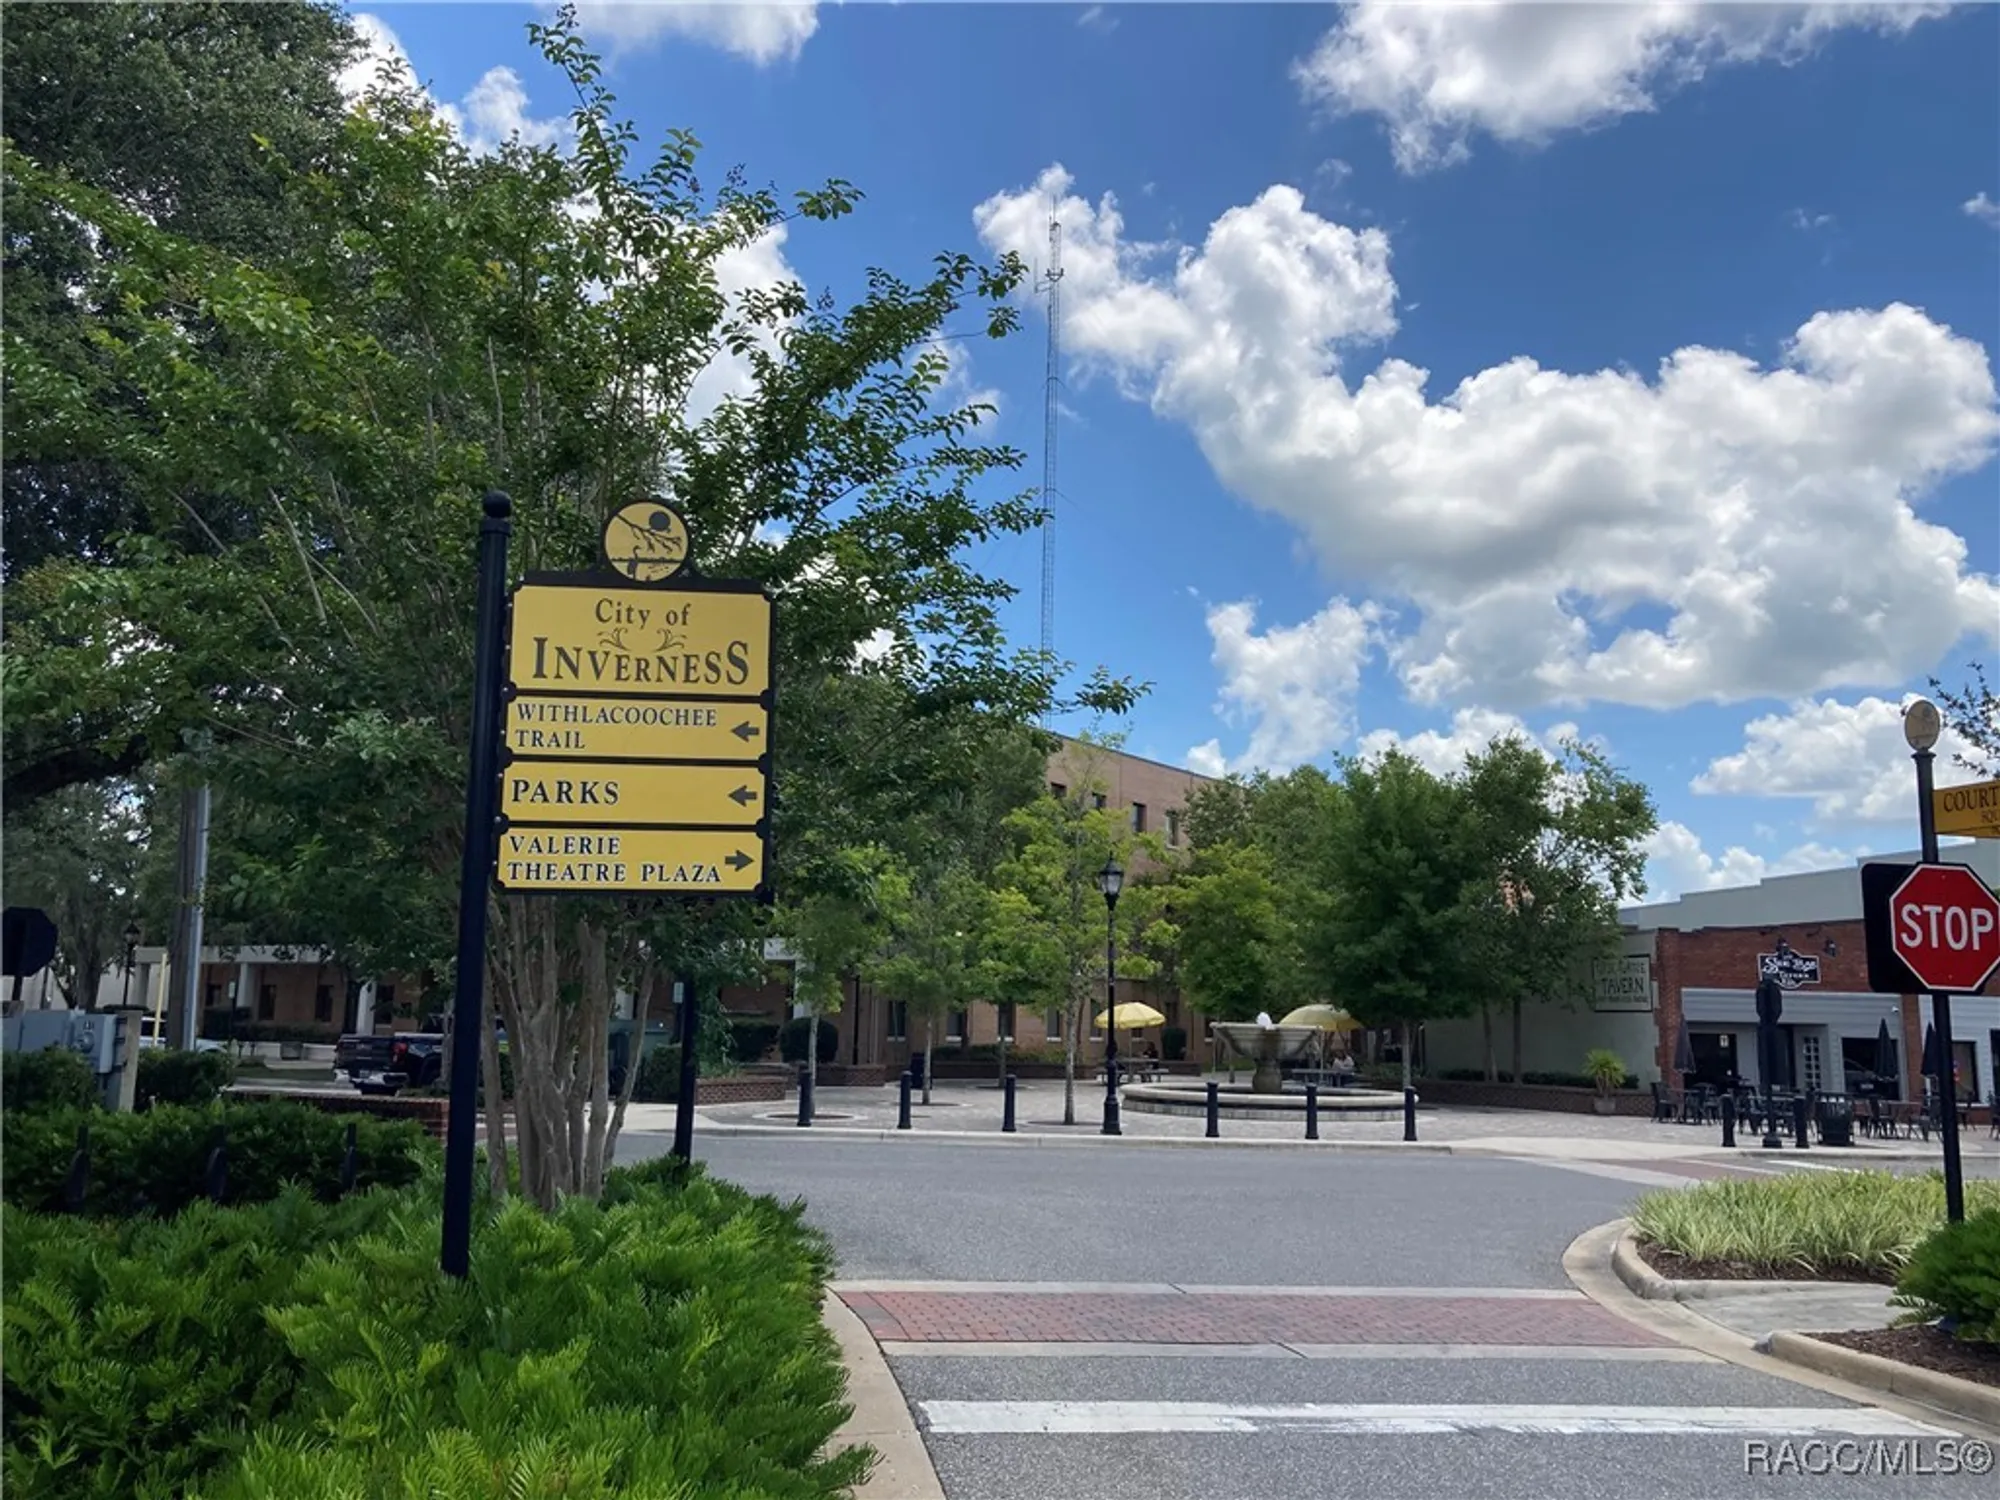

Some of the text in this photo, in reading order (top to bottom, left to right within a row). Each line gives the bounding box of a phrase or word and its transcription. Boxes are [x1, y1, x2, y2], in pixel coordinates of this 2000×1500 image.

[595, 598, 691, 629] City of
[533, 637, 748, 685] INVERNESS
[517, 703, 717, 727] WITHLACOOCHEE
[515, 729, 585, 749] TRAIL
[512, 779, 619, 805] PARKS
[1943, 786, 2000, 812] COURT
[510, 836, 621, 855] VALERIE
[508, 862, 721, 883] THEATRE PLAZA
[1901, 903, 1993, 951] STOP
[1601, 977, 1644, 995] TAVERN
